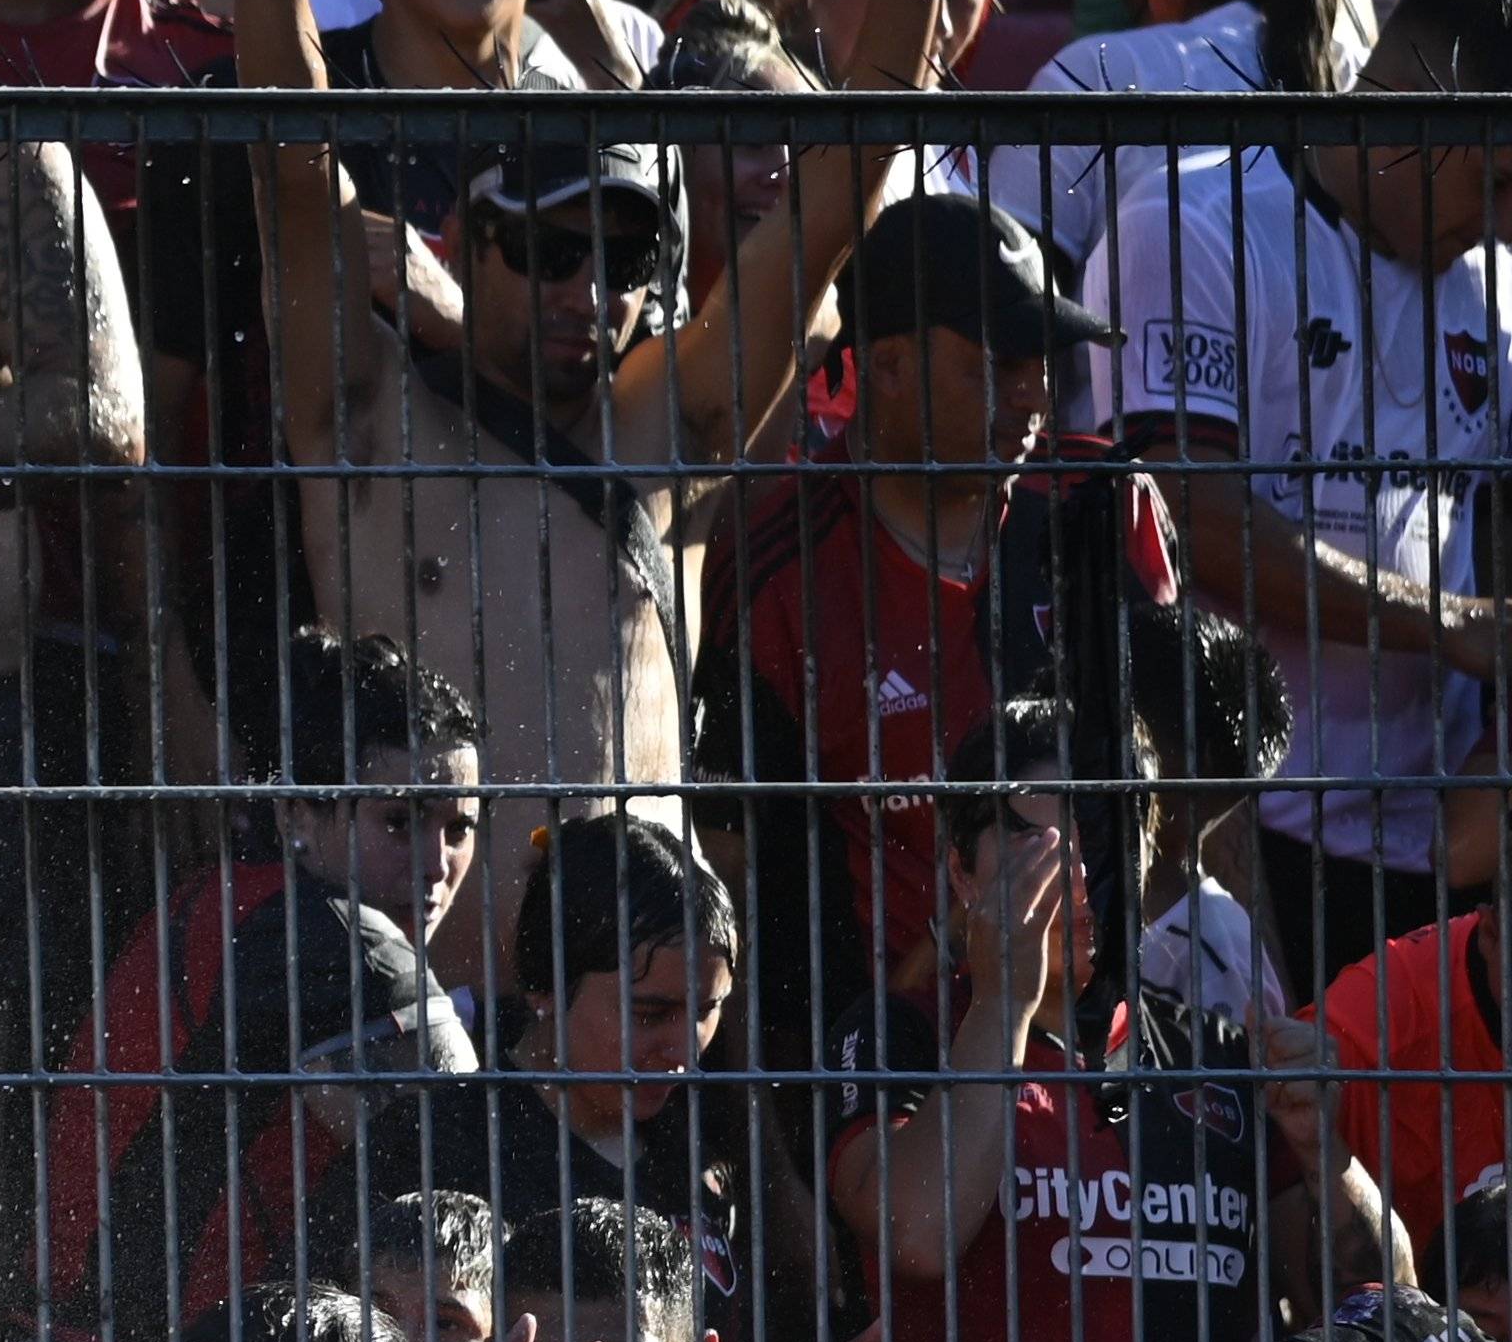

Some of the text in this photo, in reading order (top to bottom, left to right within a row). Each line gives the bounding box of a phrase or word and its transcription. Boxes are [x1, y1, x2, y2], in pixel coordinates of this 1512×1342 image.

[1161, 331, 1235, 367] VOSS
[1164, 361, 1236, 394] 2000
[876, 692, 928, 718] adidas
[998, 1166, 1248, 1233] CityCenter
